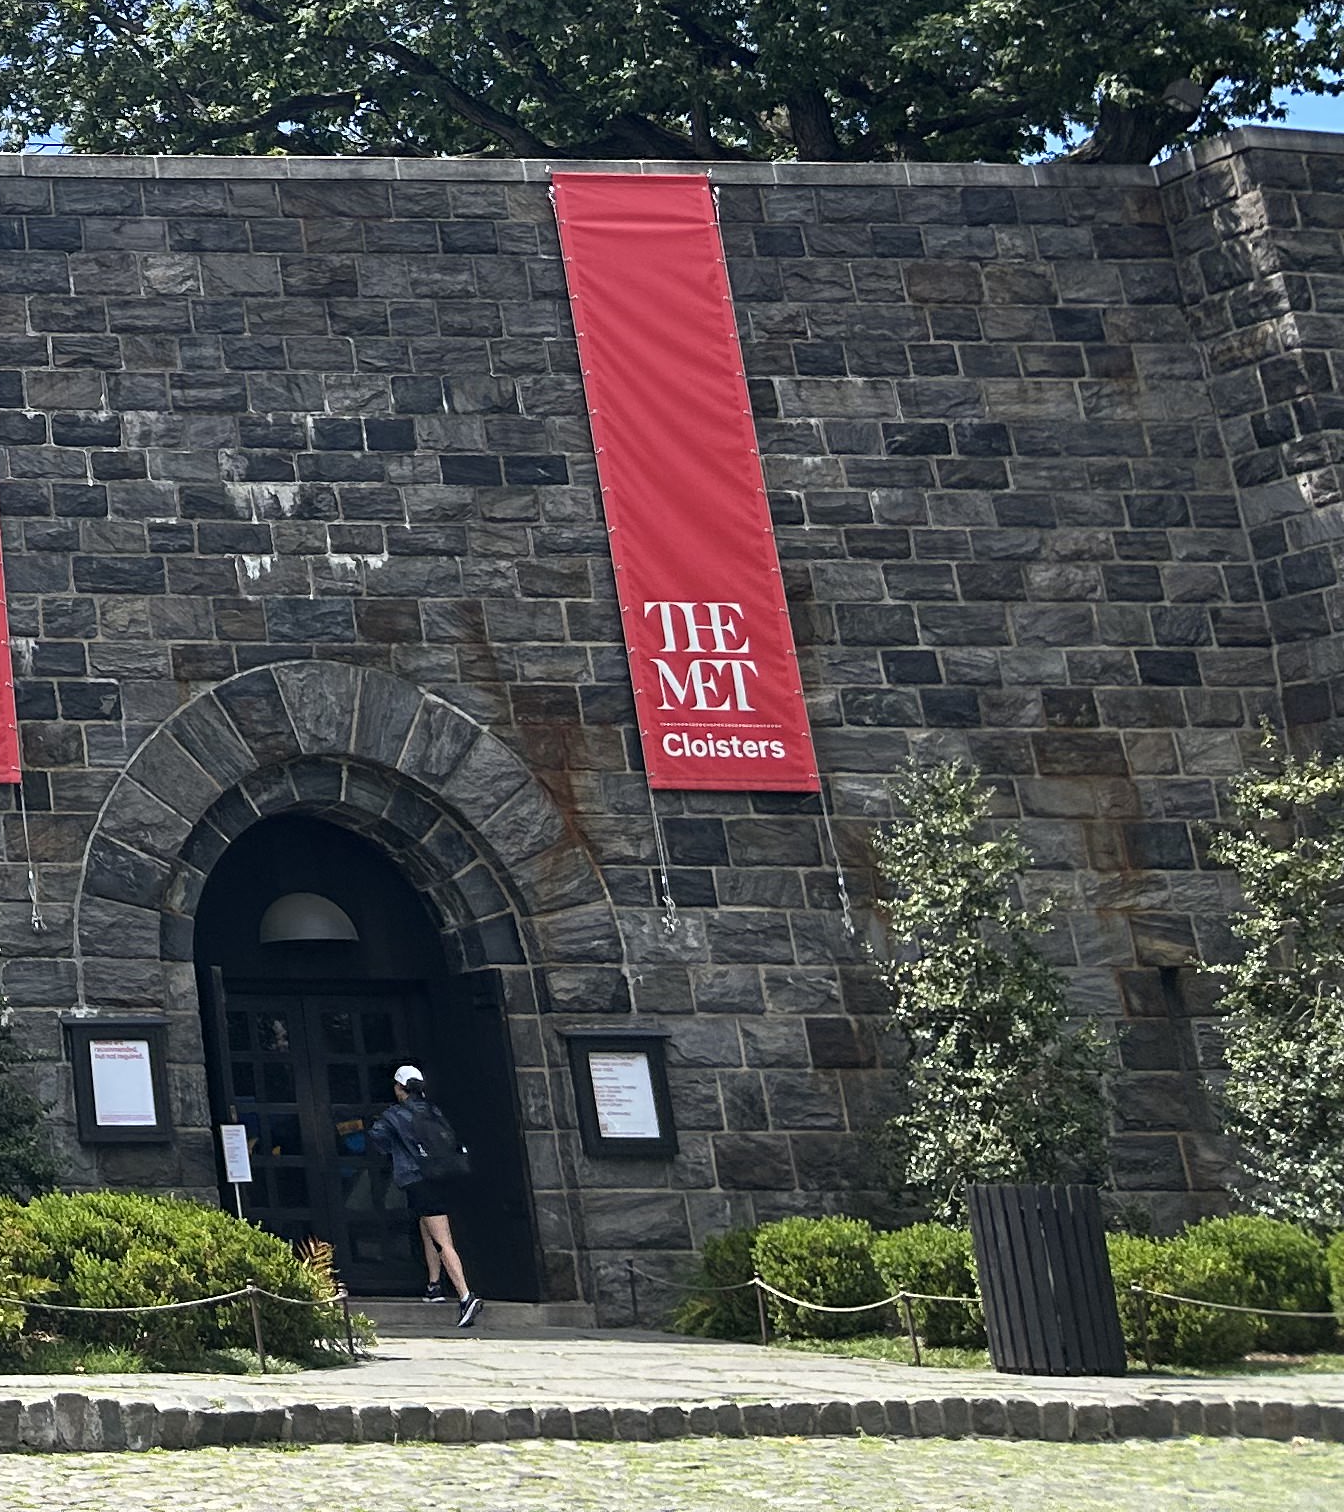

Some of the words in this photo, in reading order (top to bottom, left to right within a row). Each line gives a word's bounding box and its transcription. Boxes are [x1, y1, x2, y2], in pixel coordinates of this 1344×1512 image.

[643, 601, 749, 654] THE
[649, 658, 759, 712] MET
[662, 732, 786, 759] Cloisters
